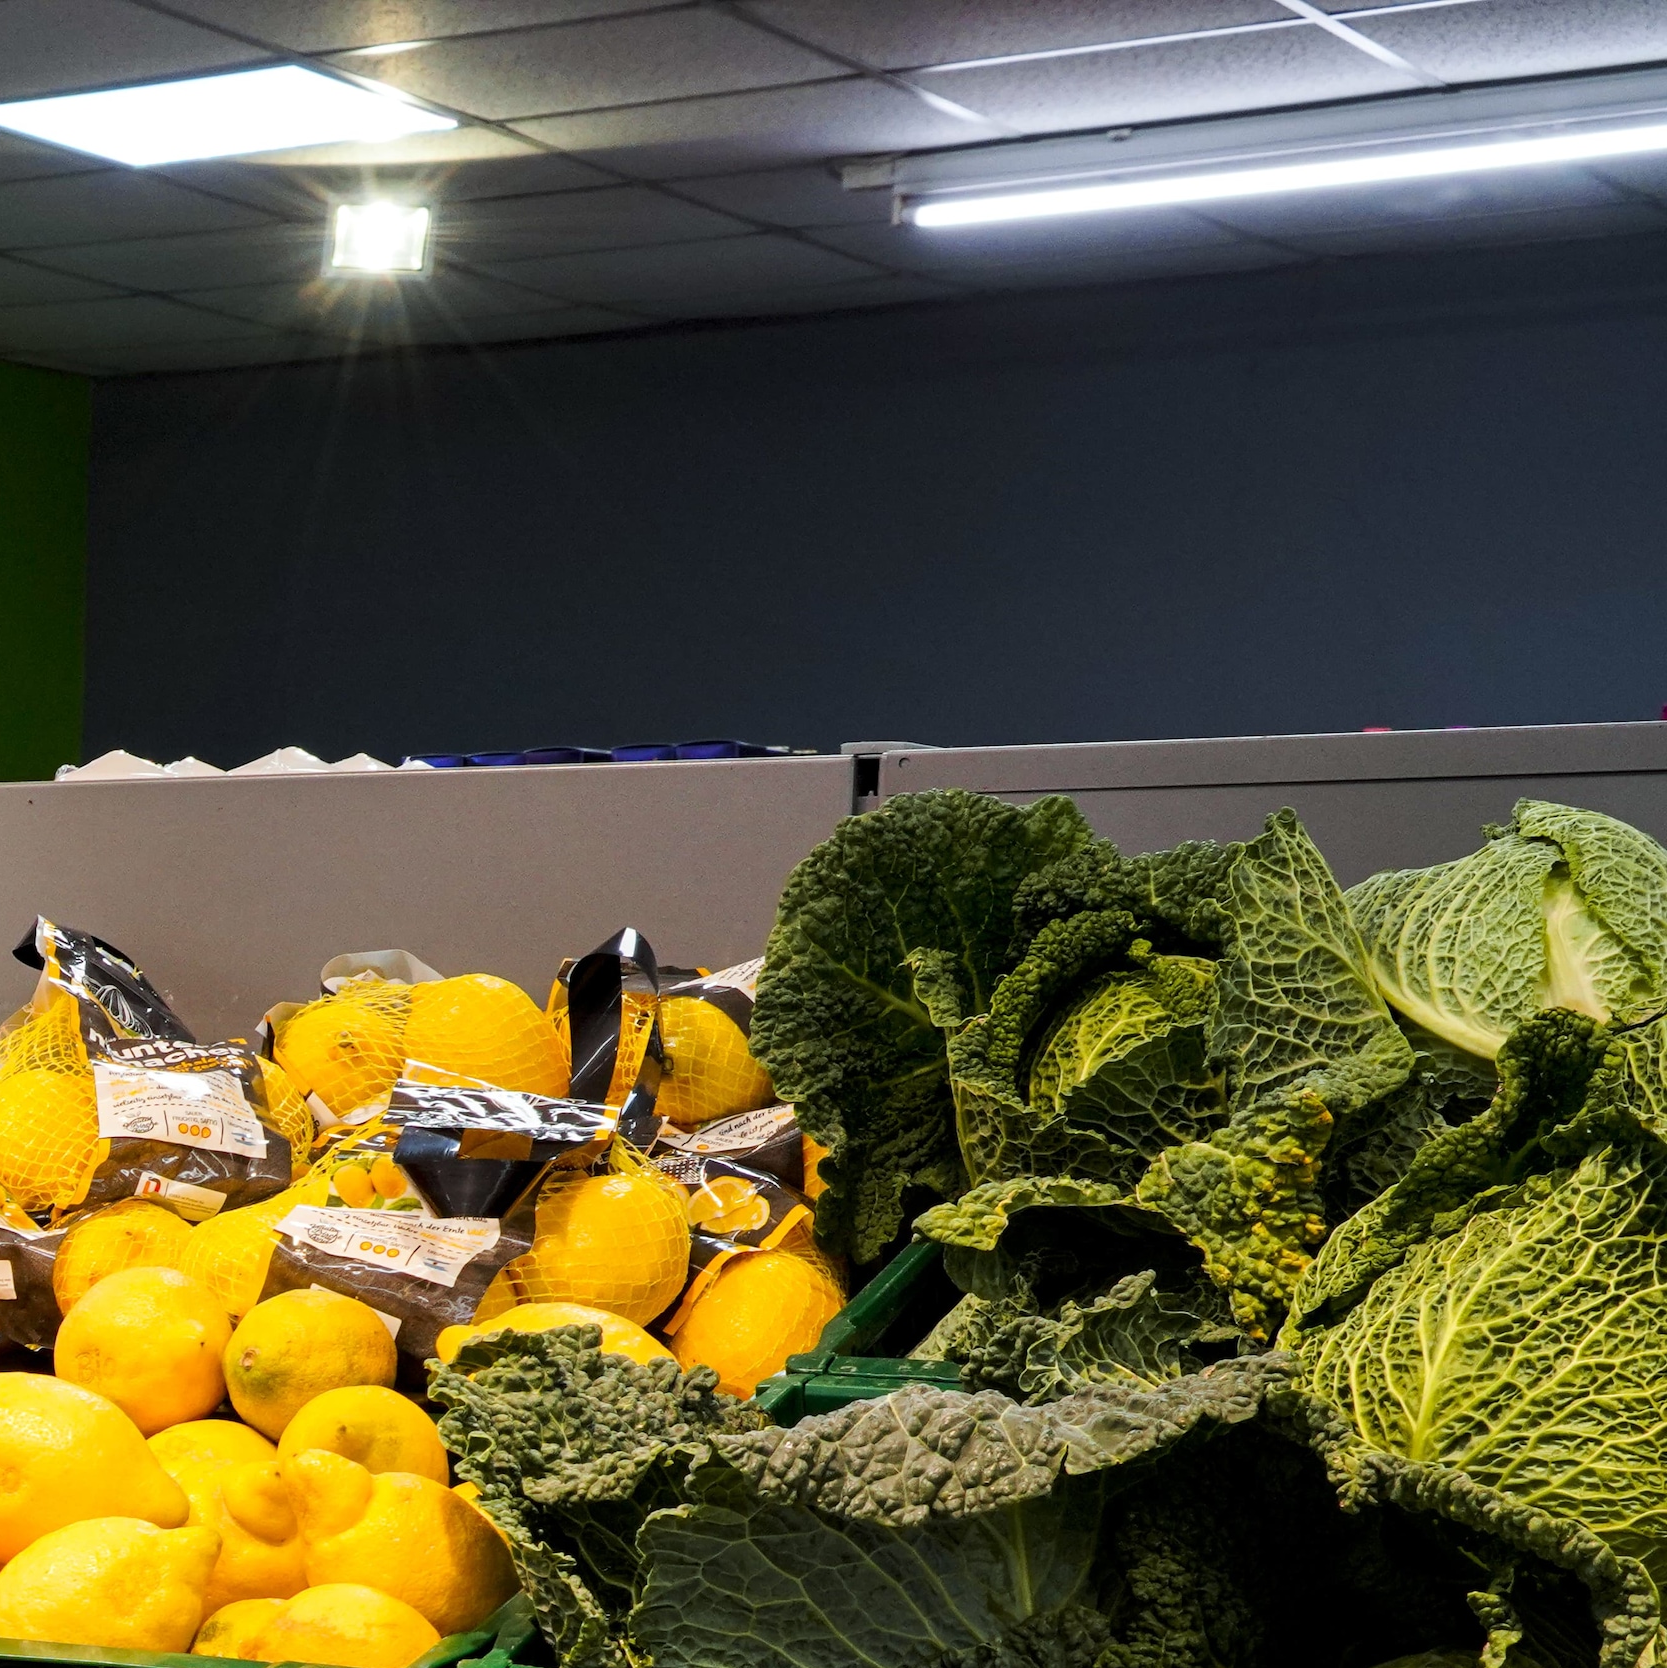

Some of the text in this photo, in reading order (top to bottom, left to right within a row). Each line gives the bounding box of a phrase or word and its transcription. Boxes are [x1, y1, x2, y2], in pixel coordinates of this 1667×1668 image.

[734, 1115, 752, 1130] nach
[753, 1110, 766, 1120] der
[425, 1221, 465, 1235] der Ernte
